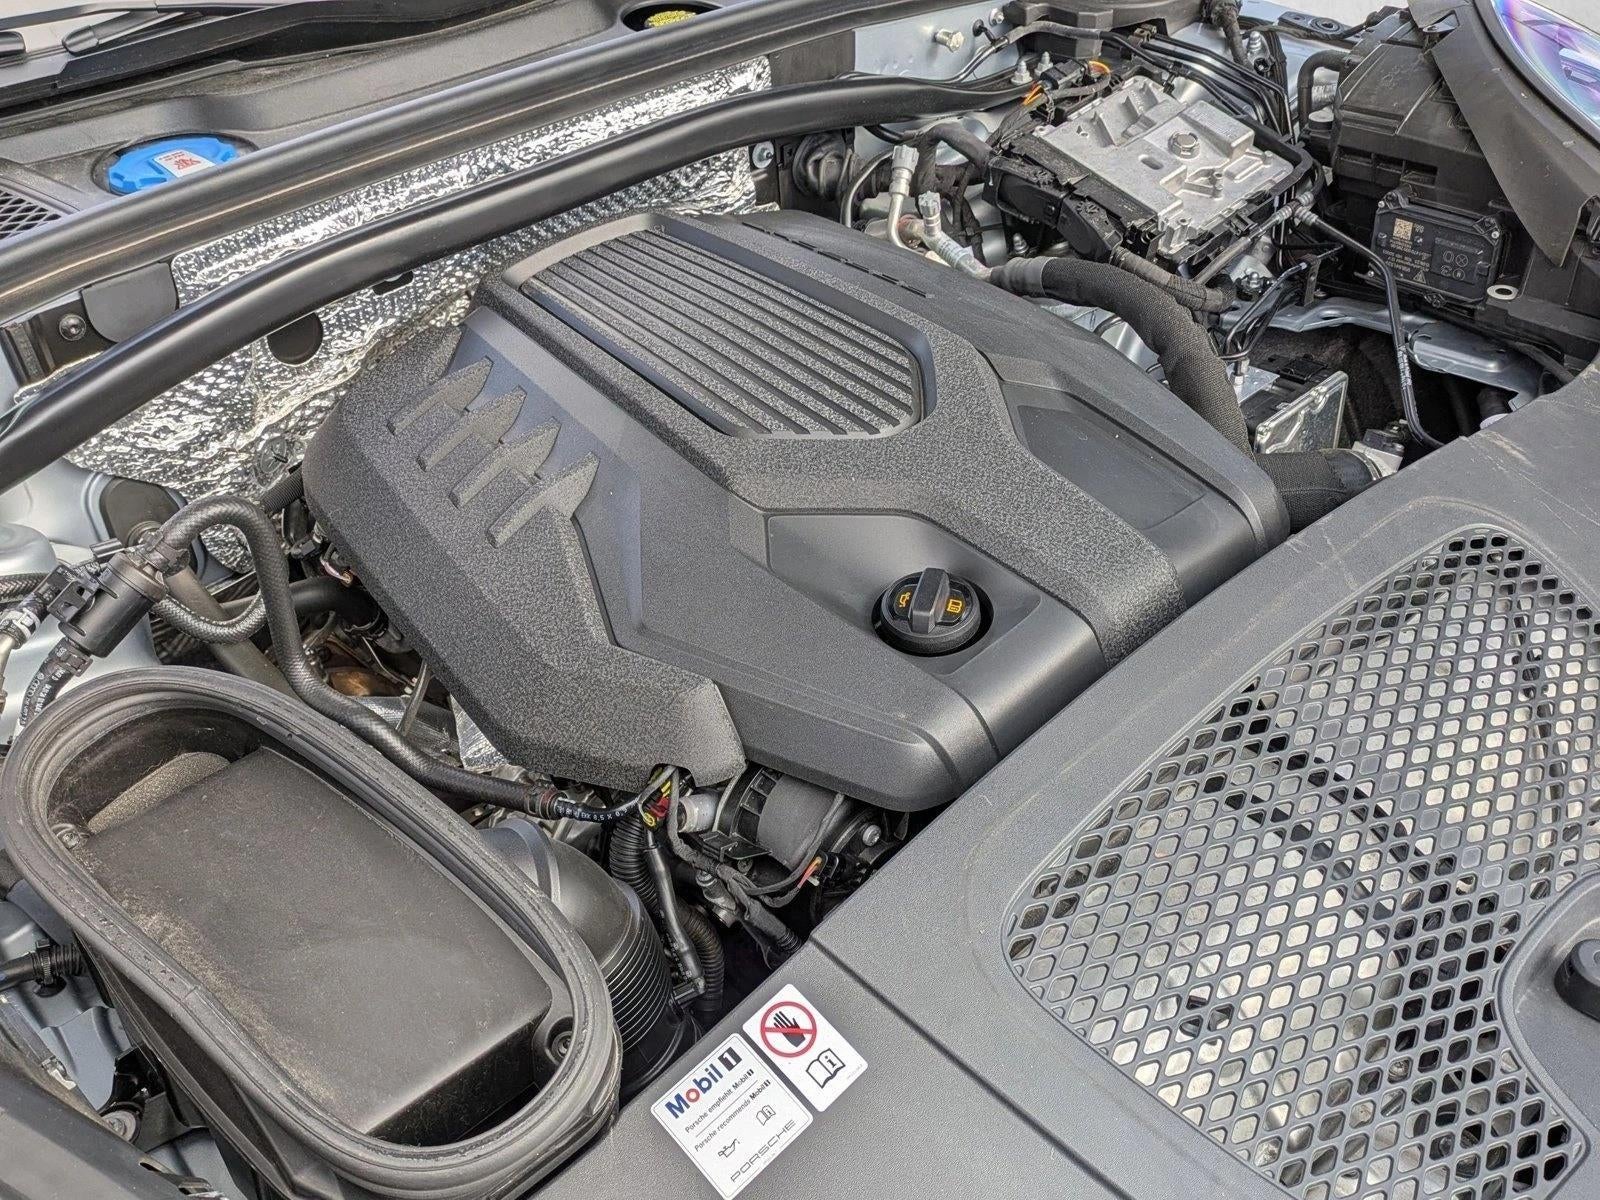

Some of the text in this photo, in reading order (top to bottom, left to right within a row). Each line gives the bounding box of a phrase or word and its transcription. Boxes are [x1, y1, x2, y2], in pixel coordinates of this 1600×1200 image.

[665, 1063, 724, 1119] Mobil
[685, 1112, 709, 1134] Porsche
[694, 1129, 717, 1152] Porsche
[717, 1099, 751, 1131] recommends
[730, 1119, 796, 1182] PORSCHE
